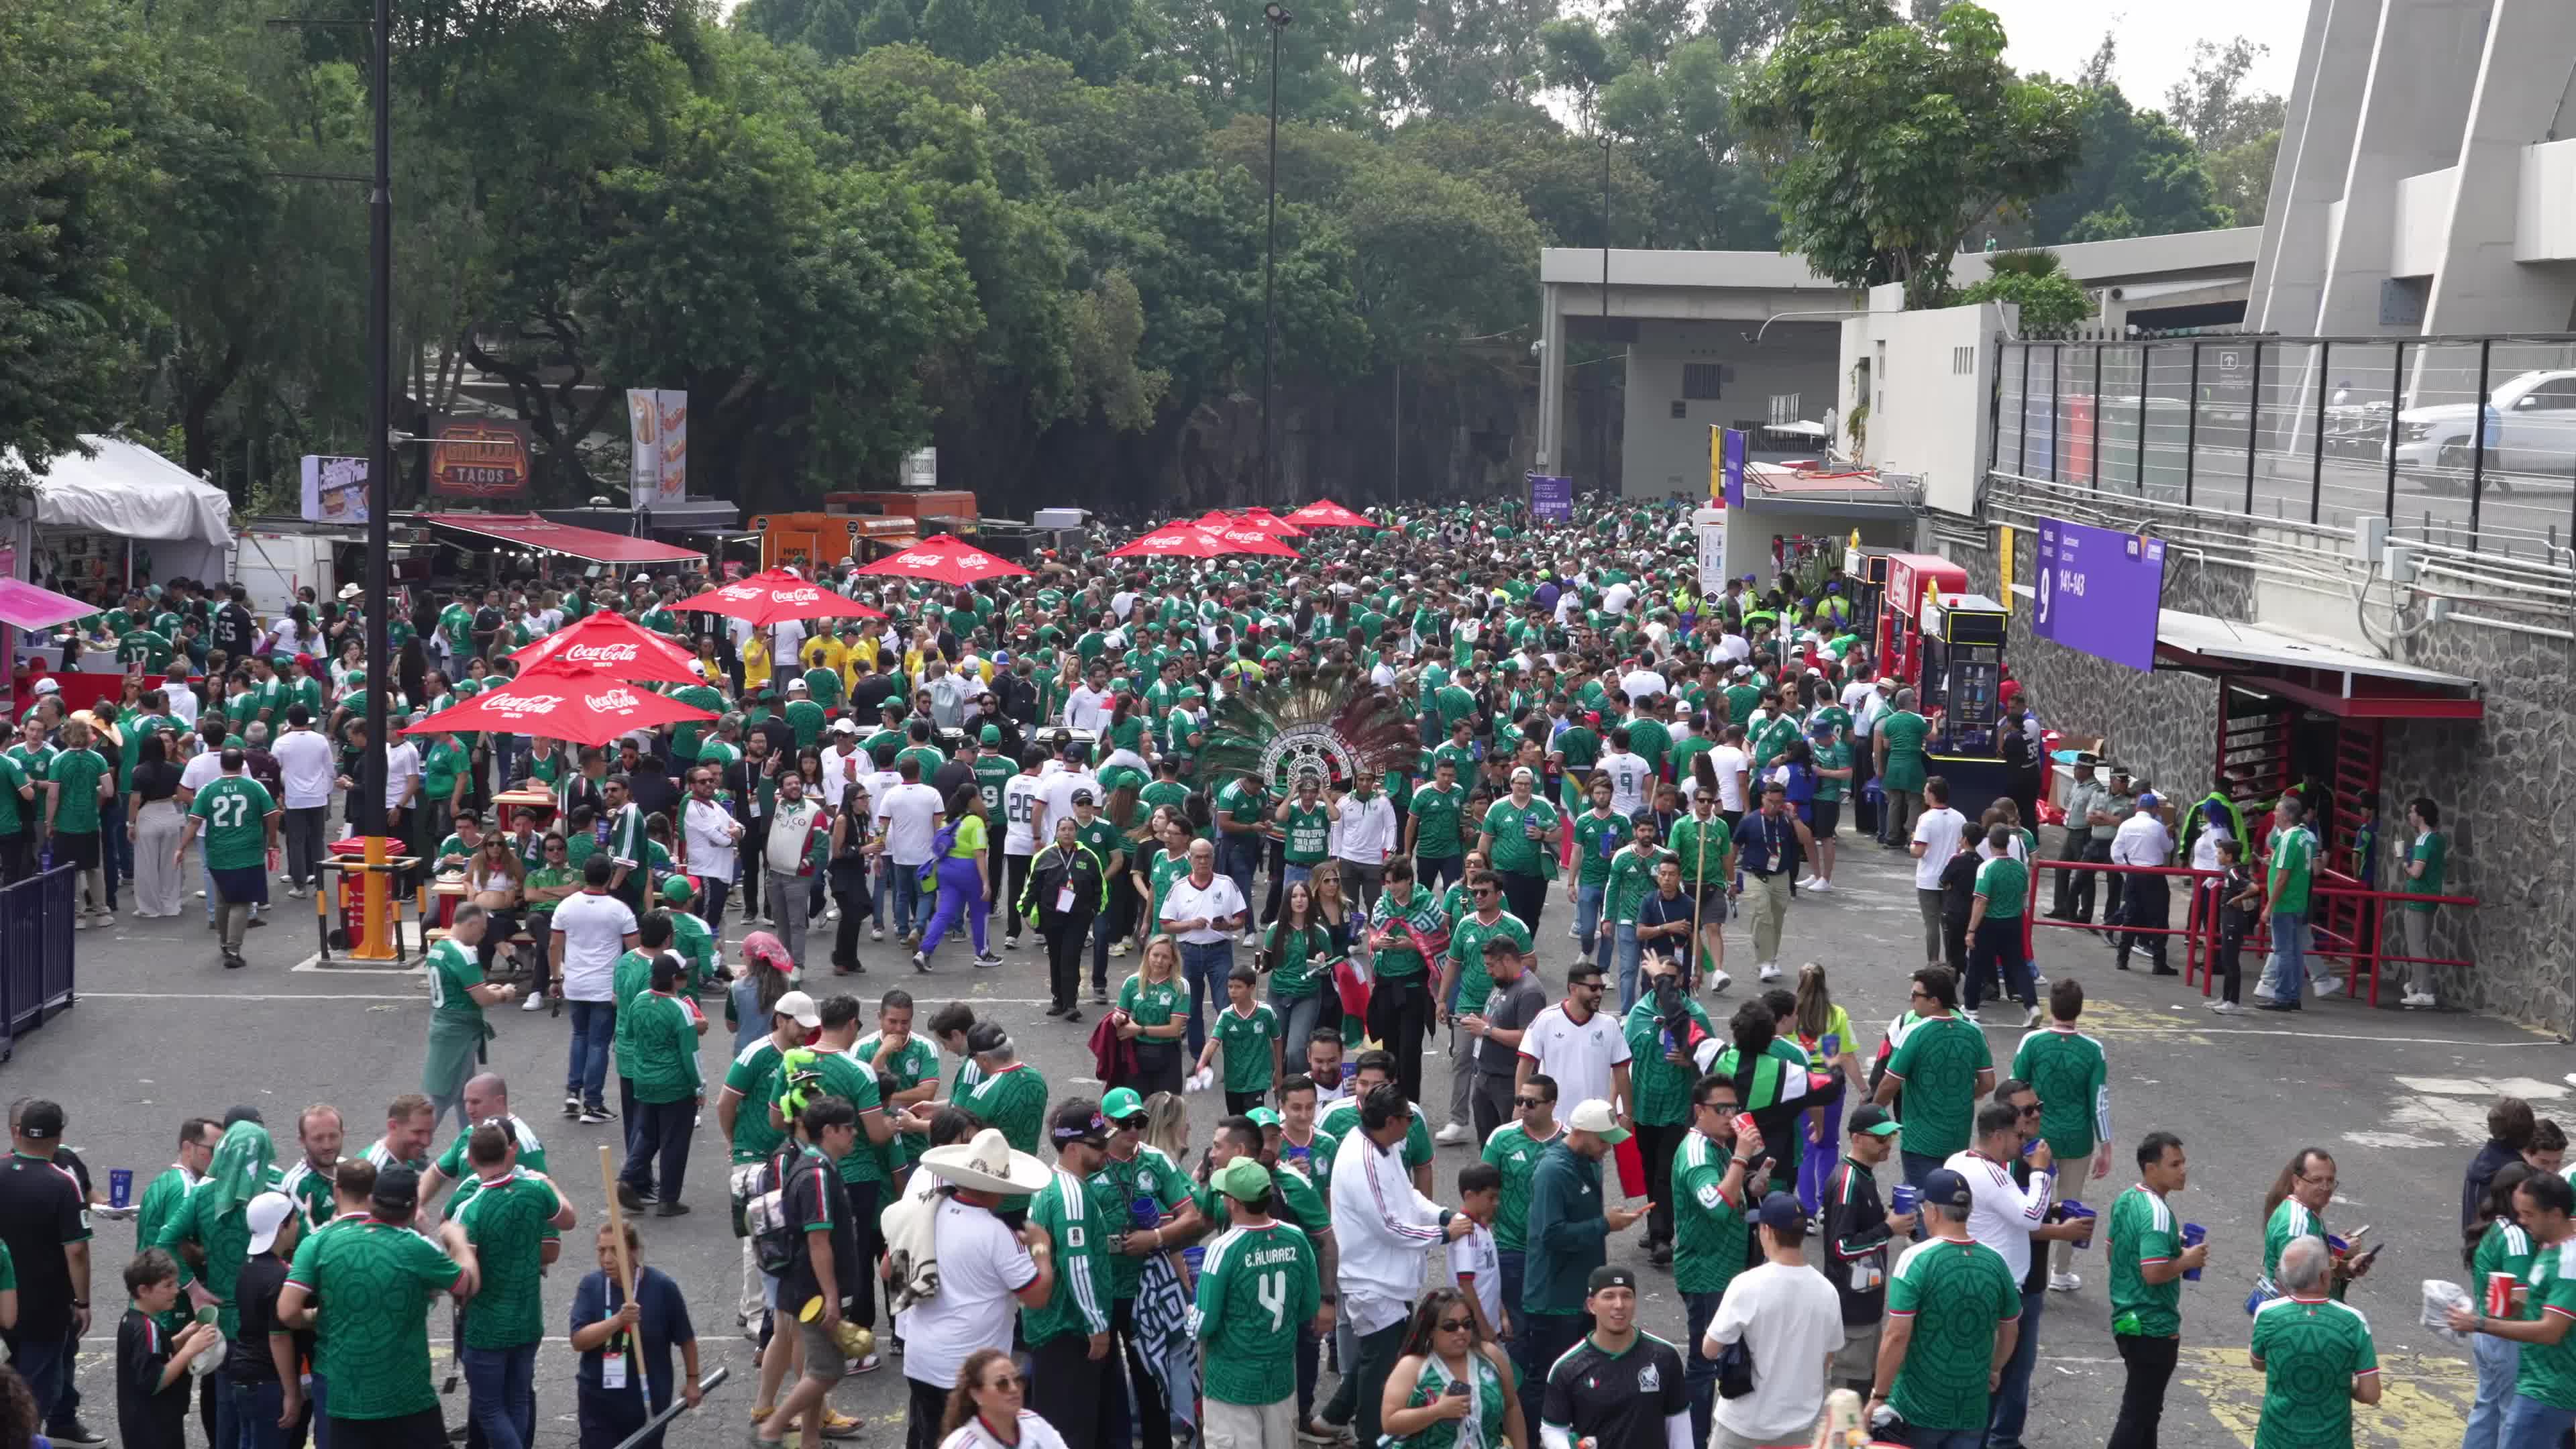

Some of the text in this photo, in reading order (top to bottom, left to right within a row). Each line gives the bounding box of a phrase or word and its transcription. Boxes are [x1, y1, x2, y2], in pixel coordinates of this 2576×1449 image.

[457, 468, 504, 482] TACOS
[1143, 536, 1186, 546] Coca-Cola
[1226, 531, 1266, 541] Coca-Cola
[783, 547, 807, 556] HOT
[2059, 568, 2085, 596] 141-143
[771, 588, 820, 603] Coca-Cola
[2039, 567, 2050, 623] 9
[566, 643, 641, 662] Coca-Cola
[481, 693, 566, 714] Coca-Cola
[585, 688, 640, 713] Coca-Cola
[1620, 772, 1632, 794] 9
[981, 785, 998, 808] 9
[212, 794, 247, 827] 27
[1245, 1246, 1297, 1267] E.ÁLVAREZ
[1258, 1270, 1286, 1333] 4
